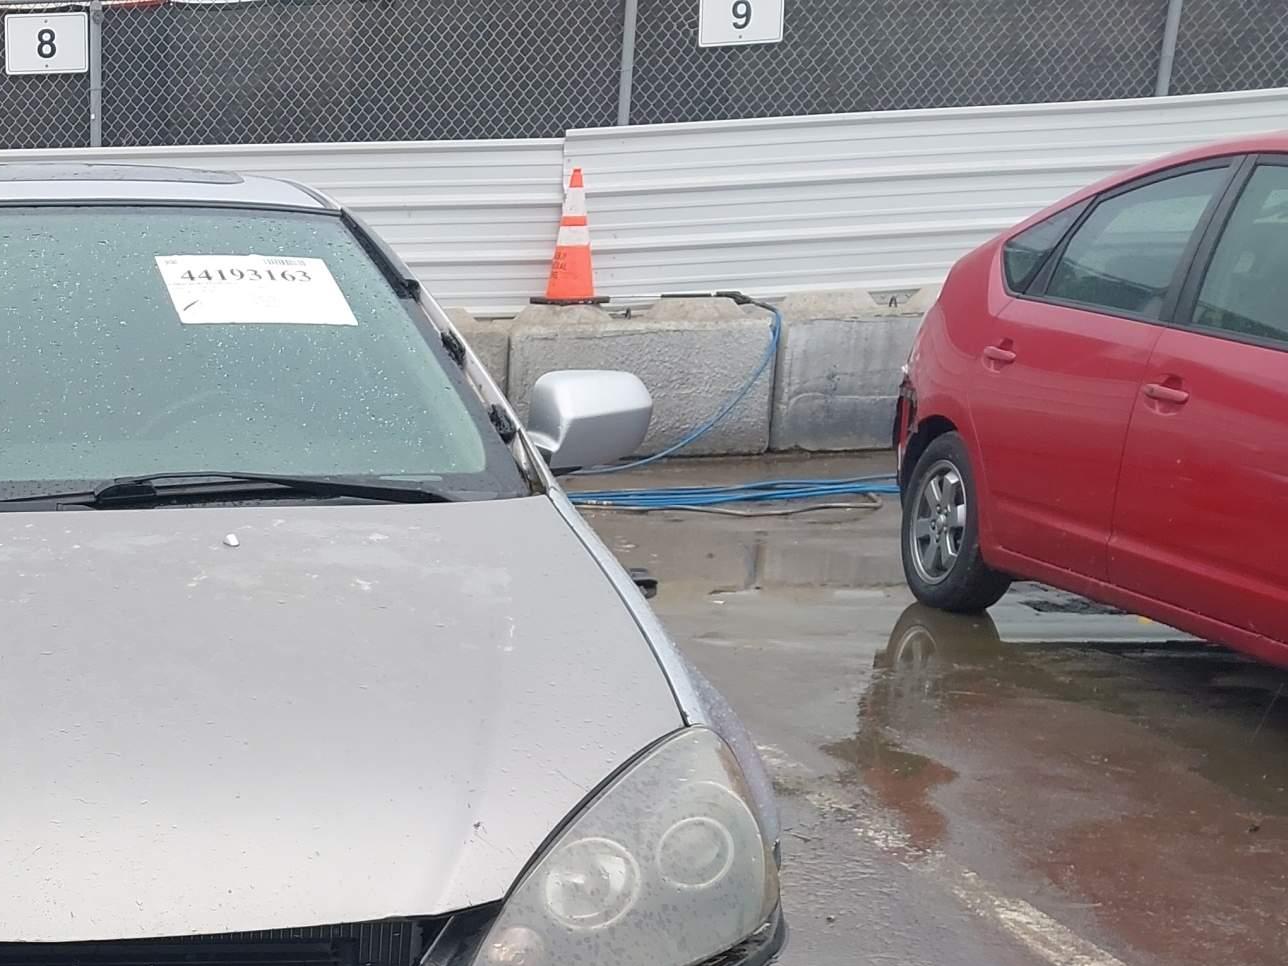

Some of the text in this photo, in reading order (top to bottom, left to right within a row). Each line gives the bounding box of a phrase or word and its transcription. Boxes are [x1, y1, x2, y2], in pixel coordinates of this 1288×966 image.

[732, 0, 752, 29] 9
[37, 28, 57, 59] 8
[180, 268, 312, 282] 44193163
